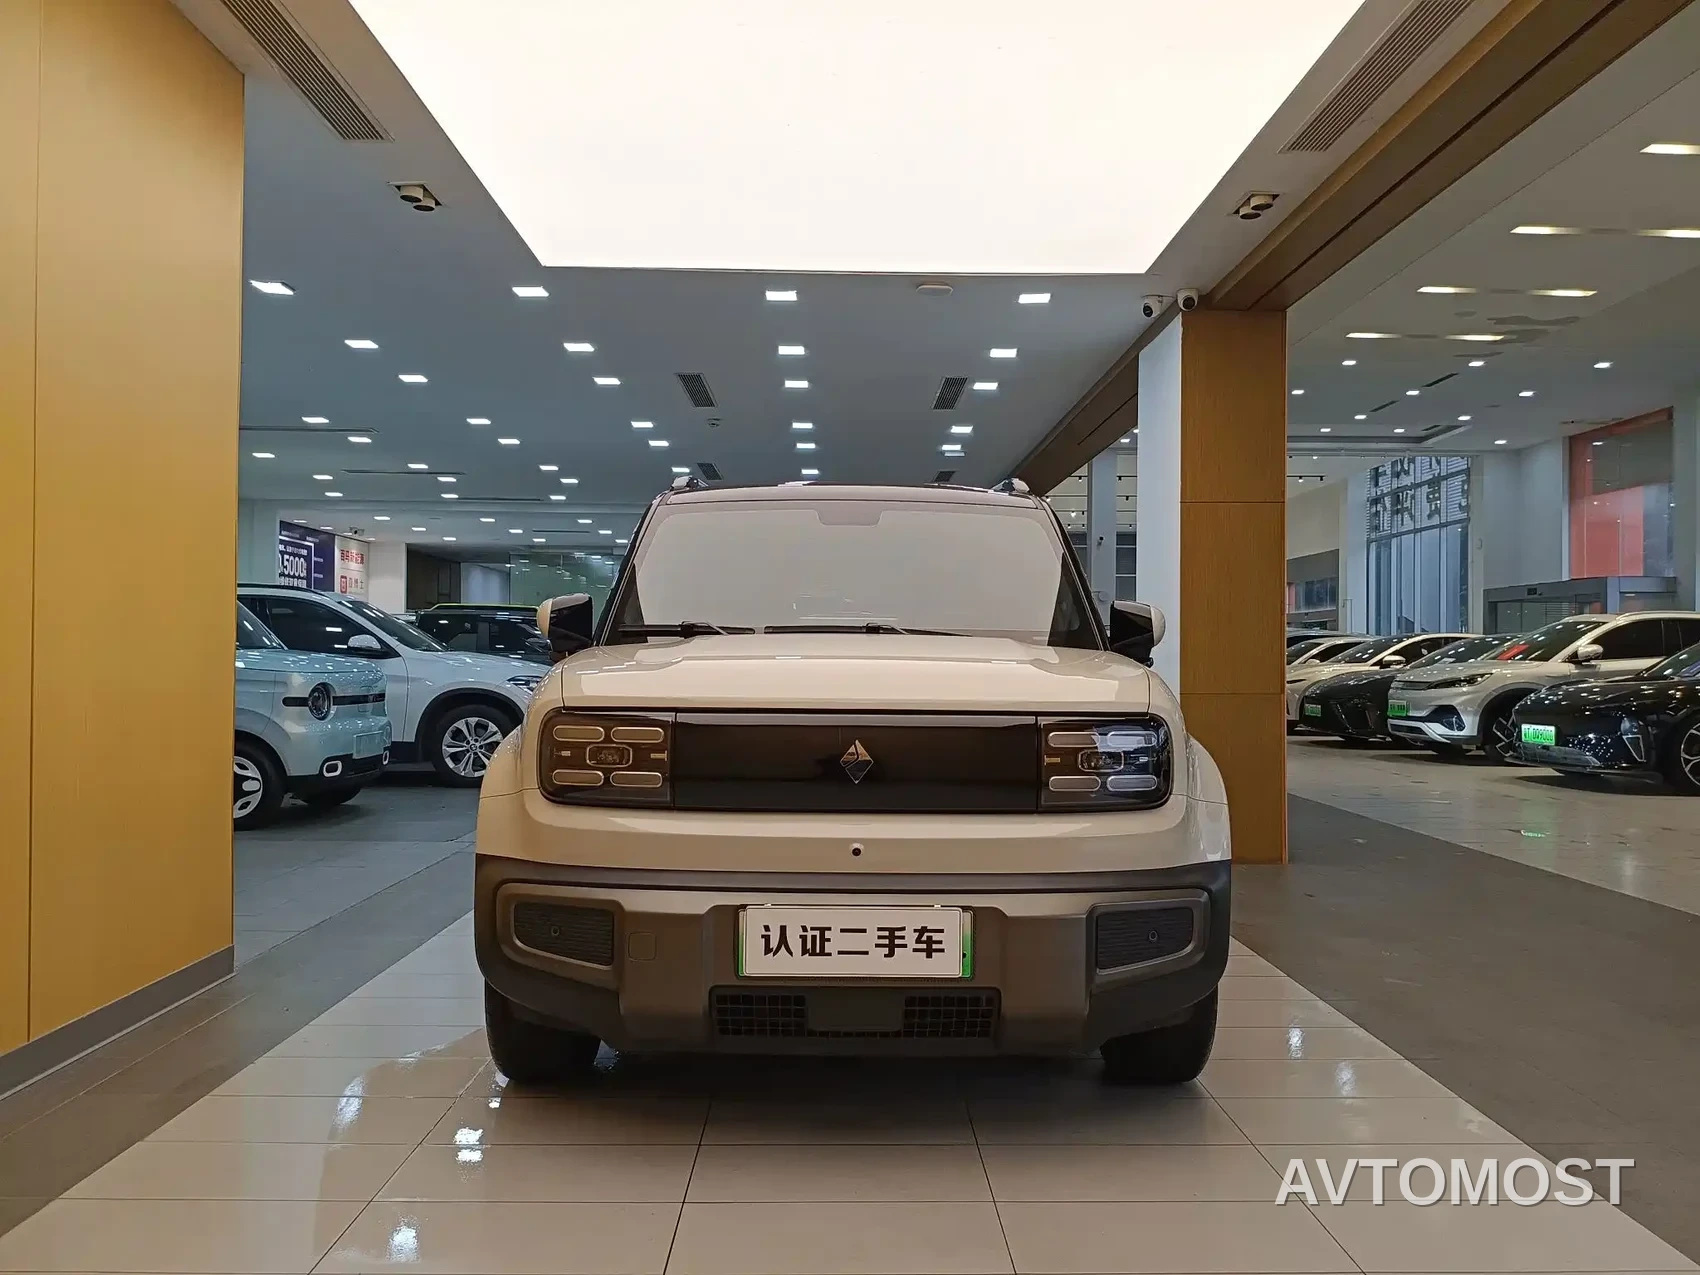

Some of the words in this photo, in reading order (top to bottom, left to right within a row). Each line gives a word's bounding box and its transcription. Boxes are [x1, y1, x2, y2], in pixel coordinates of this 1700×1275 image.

[761, 925, 945, 959] 认证二手车
